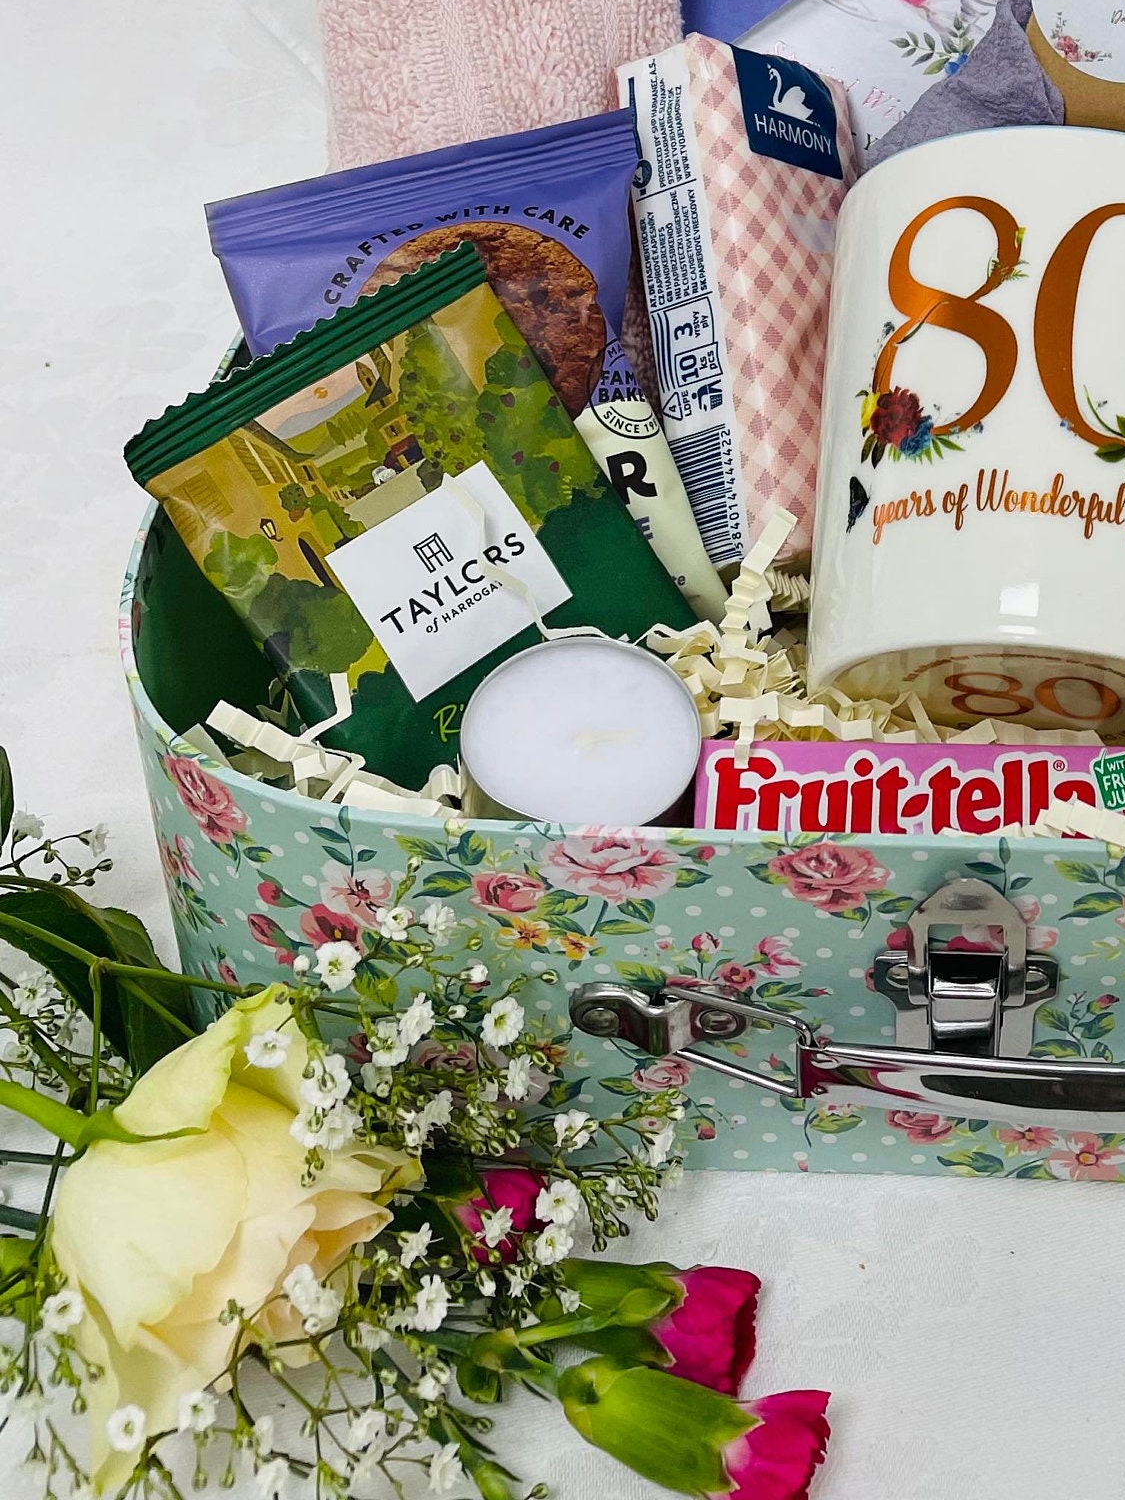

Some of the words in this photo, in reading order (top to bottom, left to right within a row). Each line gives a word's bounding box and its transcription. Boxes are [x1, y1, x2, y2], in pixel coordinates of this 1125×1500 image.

[753, 112, 832, 156] HARMONY
[655, 147, 667, 188] PRODUCED
[664, 159, 672, 169] 03
[666, 169, 674, 184] 976
[323, 222, 425, 305] CRAFTED
[435, 205, 510, 223] WITH
[522, 205, 591, 241] CARE
[657, 227, 673, 290] HANDKERCHIEFS
[676, 238, 690, 285] CHUSTECZKI
[648, 284, 655, 295] DE
[683, 285, 690, 296] PL
[691, 282, 699, 293] RU
[699, 278, 707, 291] SK
[658, 294, 665, 305] CZ
[666, 291, 673, 302] GB
[674, 288, 682, 300] HU
[674, 322, 693, 340] 3
[692, 311, 701, 338] vrstvy
[701, 315, 709, 329] ply
[679, 354, 699, 382] 10
[699, 356, 708, 370] ks
[707, 350, 718, 370] pcs
[669, 404, 676, 412] 4
[681, 390, 692, 416] LDPE
[603, 410, 640, 433] SINCE
[720, 429, 736, 485] 444422
[872, 485, 937, 545] years
[942, 482, 969, 531] of
[975, 467, 1125, 540] Wonderful
[425, 617, 439, 634] of
[944, 671, 1122, 721] 80
